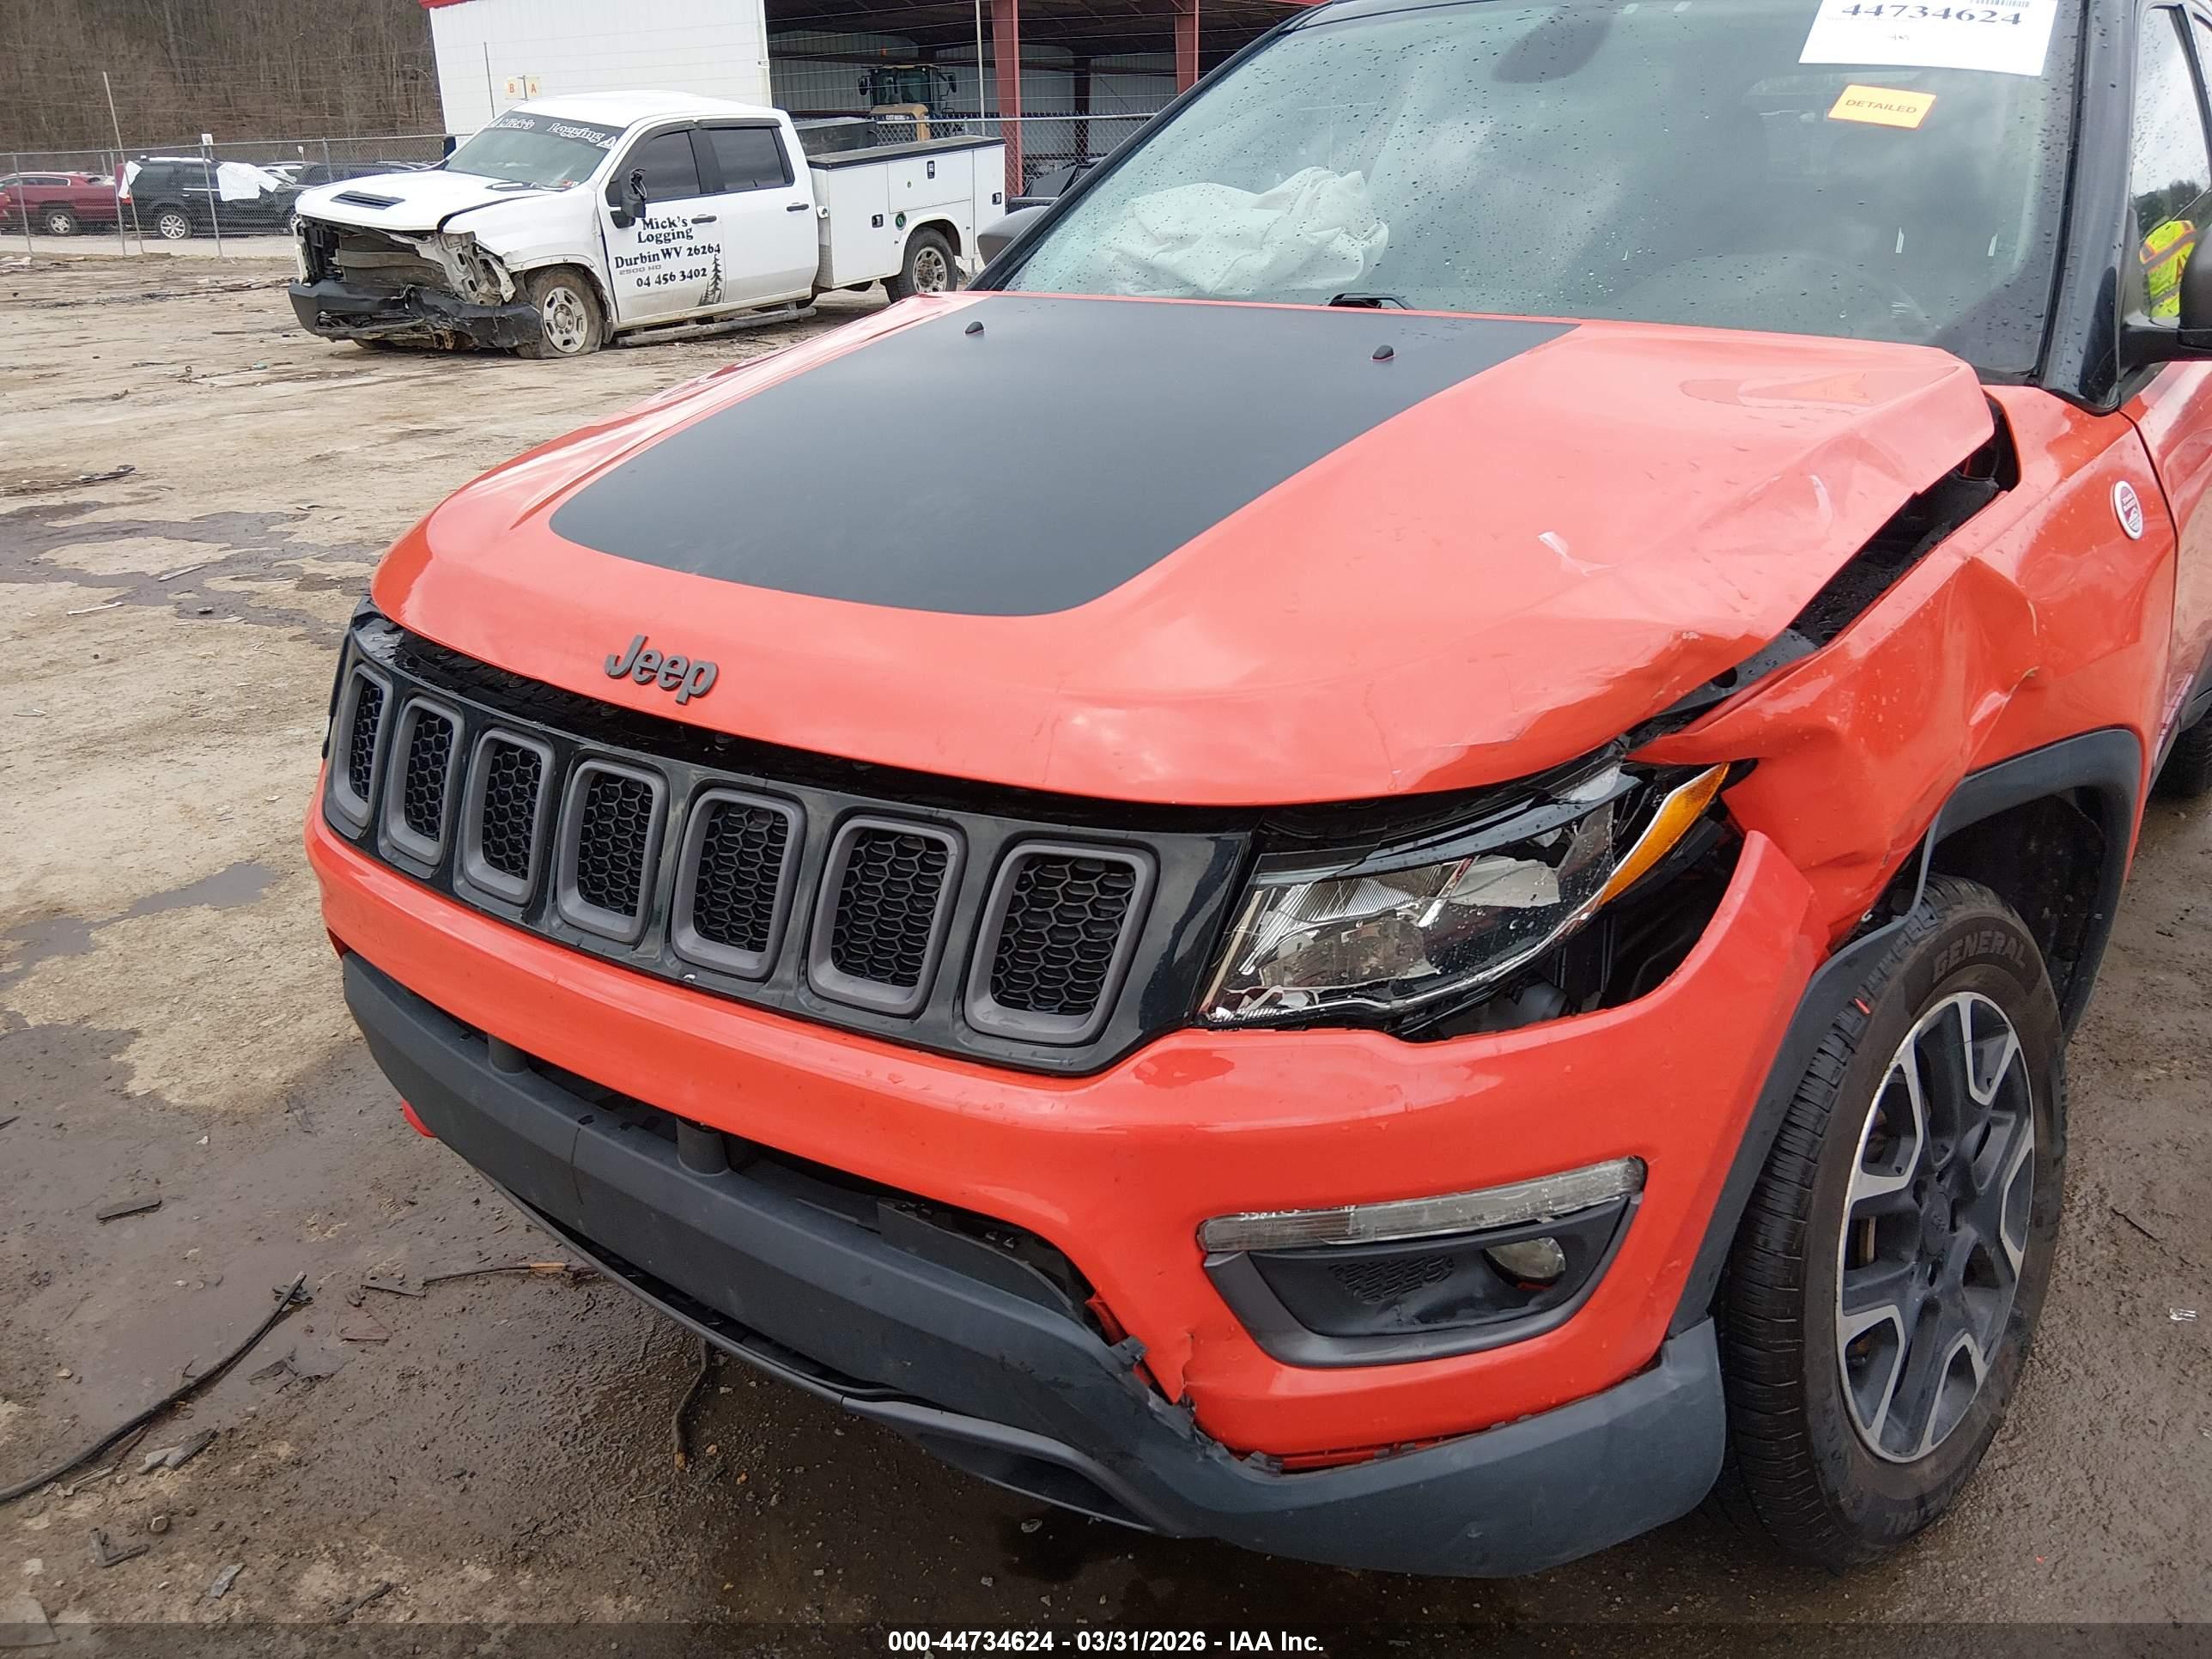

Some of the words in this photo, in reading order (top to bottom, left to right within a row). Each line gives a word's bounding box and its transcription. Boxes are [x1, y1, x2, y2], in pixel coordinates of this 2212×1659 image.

[1841, 3, 2021, 25] 44734624
[509, 83, 514, 93] B
[531, 83, 537, 93] A
[1845, 99, 1917, 113] DETAILED
[546, 123, 605, 143] Logging
[641, 216, 689, 230] Mick's
[637, 228, 694, 245] Logging
[615, 251, 660, 269] Durbin
[660, 246, 683, 260] WV
[687, 243, 721, 257] 26264
[636, 276, 652, 288] 04
[654, 272, 677, 285] 456
[678, 268, 708, 282] 3402
[605, 634, 719, 705] Jeep
[1934, 931, 2027, 981] GENERAL
